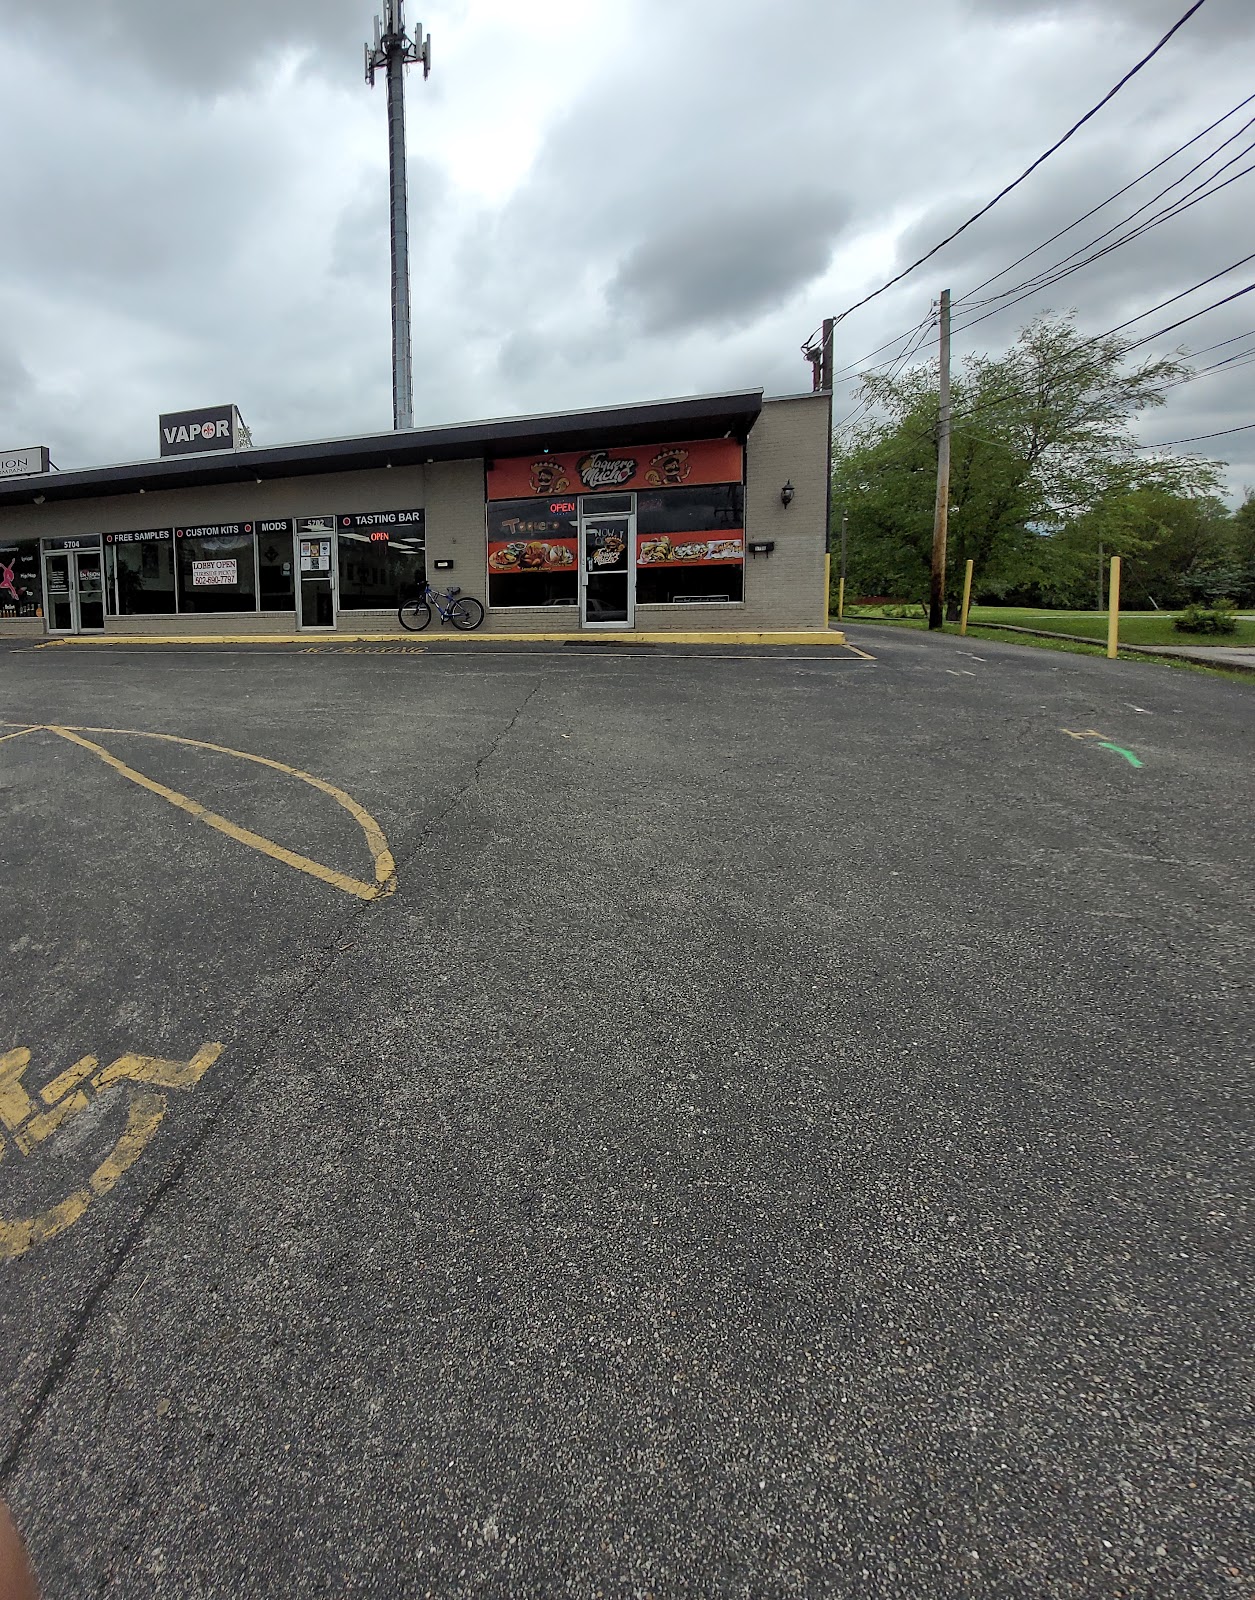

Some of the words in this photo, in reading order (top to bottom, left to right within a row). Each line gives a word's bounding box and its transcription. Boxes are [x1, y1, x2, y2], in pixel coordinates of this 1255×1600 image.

[163, 419, 230, 443] VAPOR
[1, 458, 28, 469] ION
[590, 452, 635, 471] Taquero
[581, 466, 634, 487] Mucho
[549, 502, 575, 513] OPEN
[307, 519, 325, 527] 5702
[355, 513, 396, 525] TASTING
[398, 512, 420, 522] BAR
[185, 526, 219, 537] CUSTOM
[220, 525, 239, 535] KITS
[261, 521, 287, 532] MODS
[114, 533, 133, 543] FREE
[134, 530, 170, 541] SAMPLES
[370, 532, 389, 541] OPEN
[63, 540, 80, 549] 5704
[193, 561, 215, 570] LOBBY
[216, 560, 236, 569] OPEN
